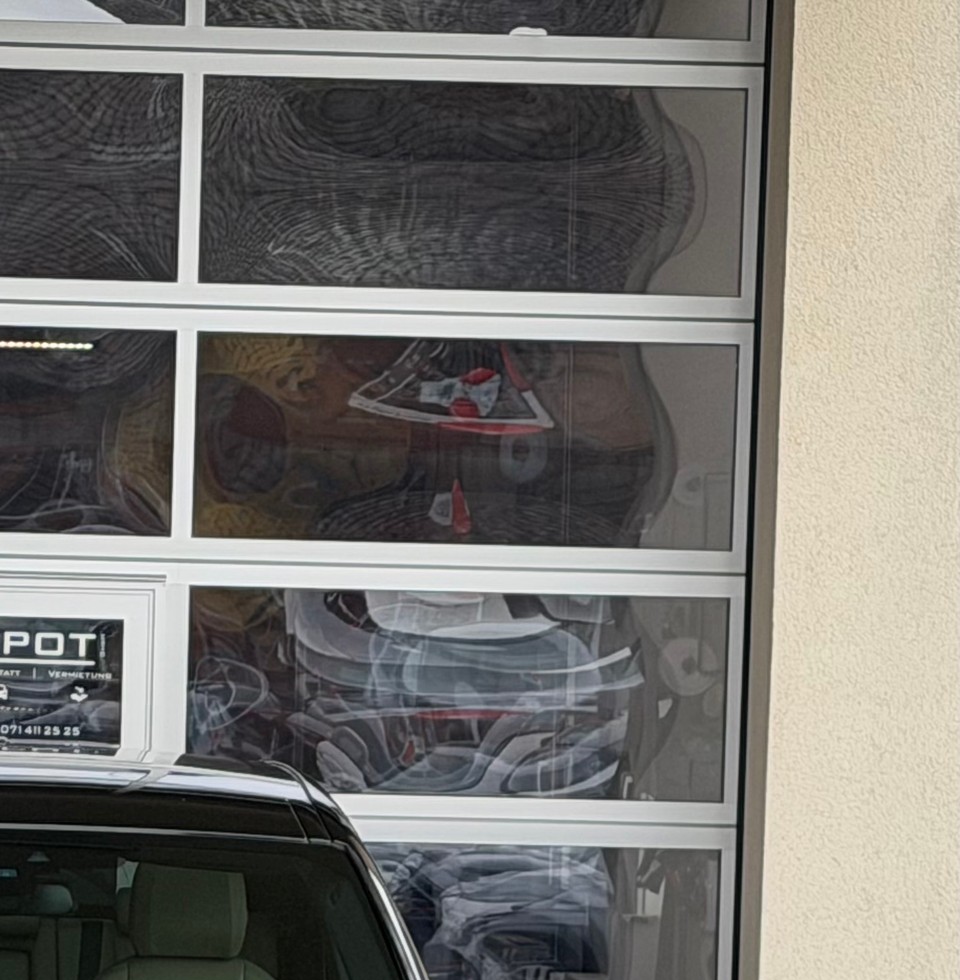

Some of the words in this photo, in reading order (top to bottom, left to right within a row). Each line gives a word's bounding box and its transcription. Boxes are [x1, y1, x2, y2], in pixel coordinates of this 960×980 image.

[48, 670, 113, 680] VERMIETUNG
[0, 724, 22, 734] 071
[43, 726, 61, 736] 25
[63, 726, 81, 737] 25
